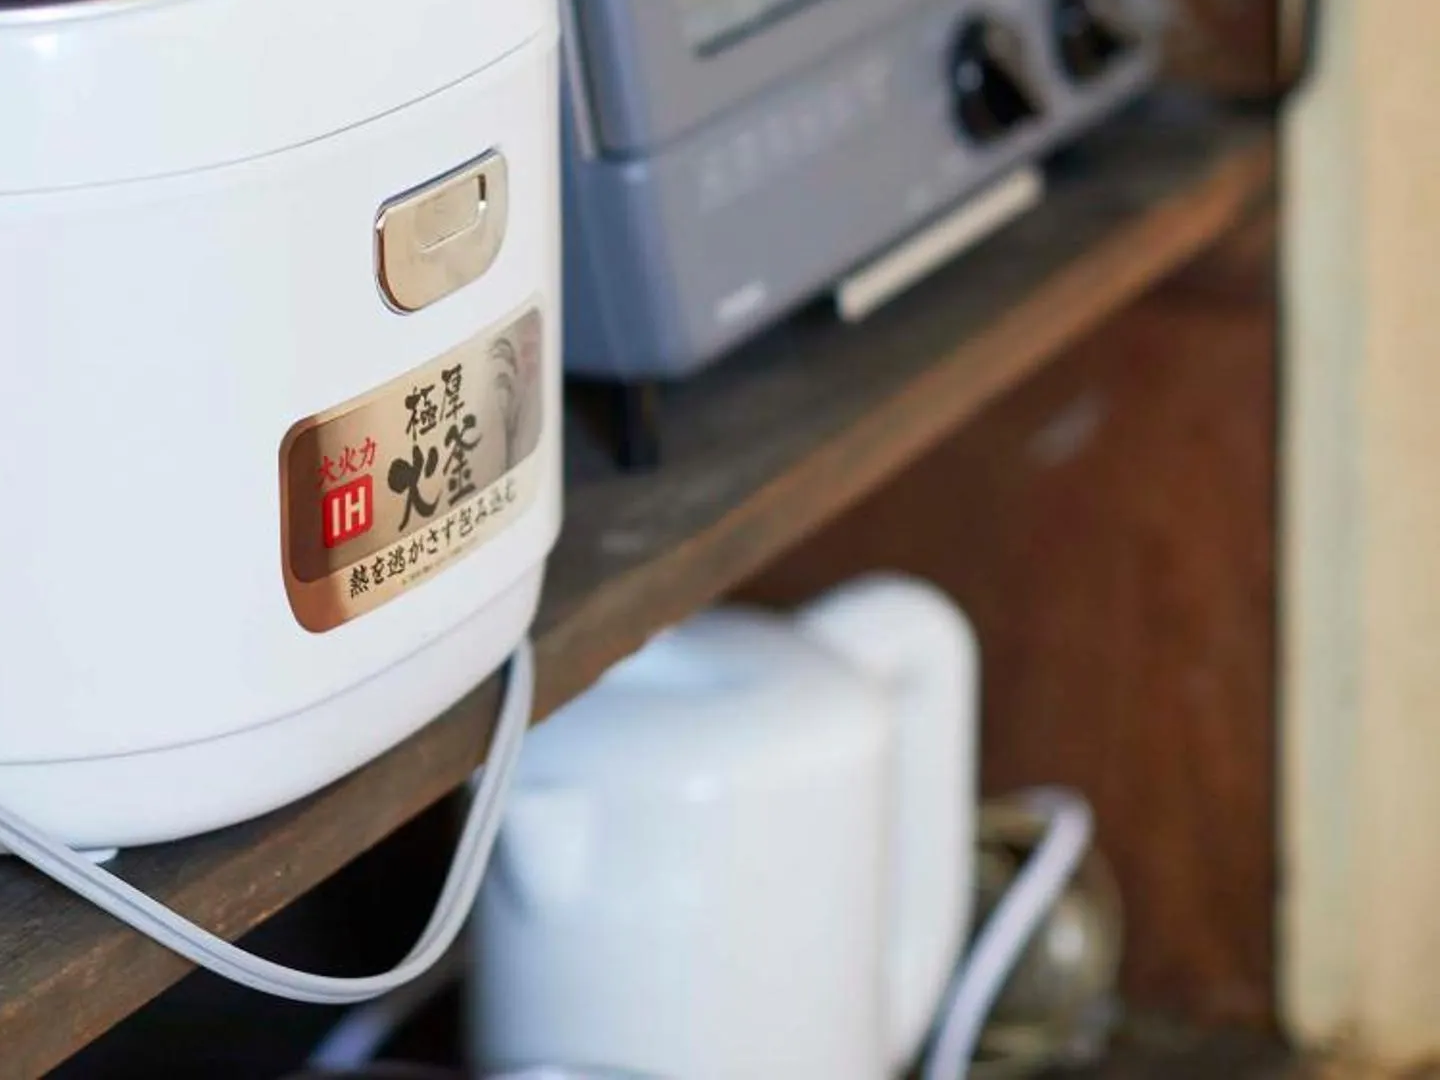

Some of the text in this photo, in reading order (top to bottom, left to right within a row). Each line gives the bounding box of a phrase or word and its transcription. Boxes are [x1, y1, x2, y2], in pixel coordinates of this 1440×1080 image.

[318, 437, 378, 485] 大火力
[329, 483, 369, 540] IH
